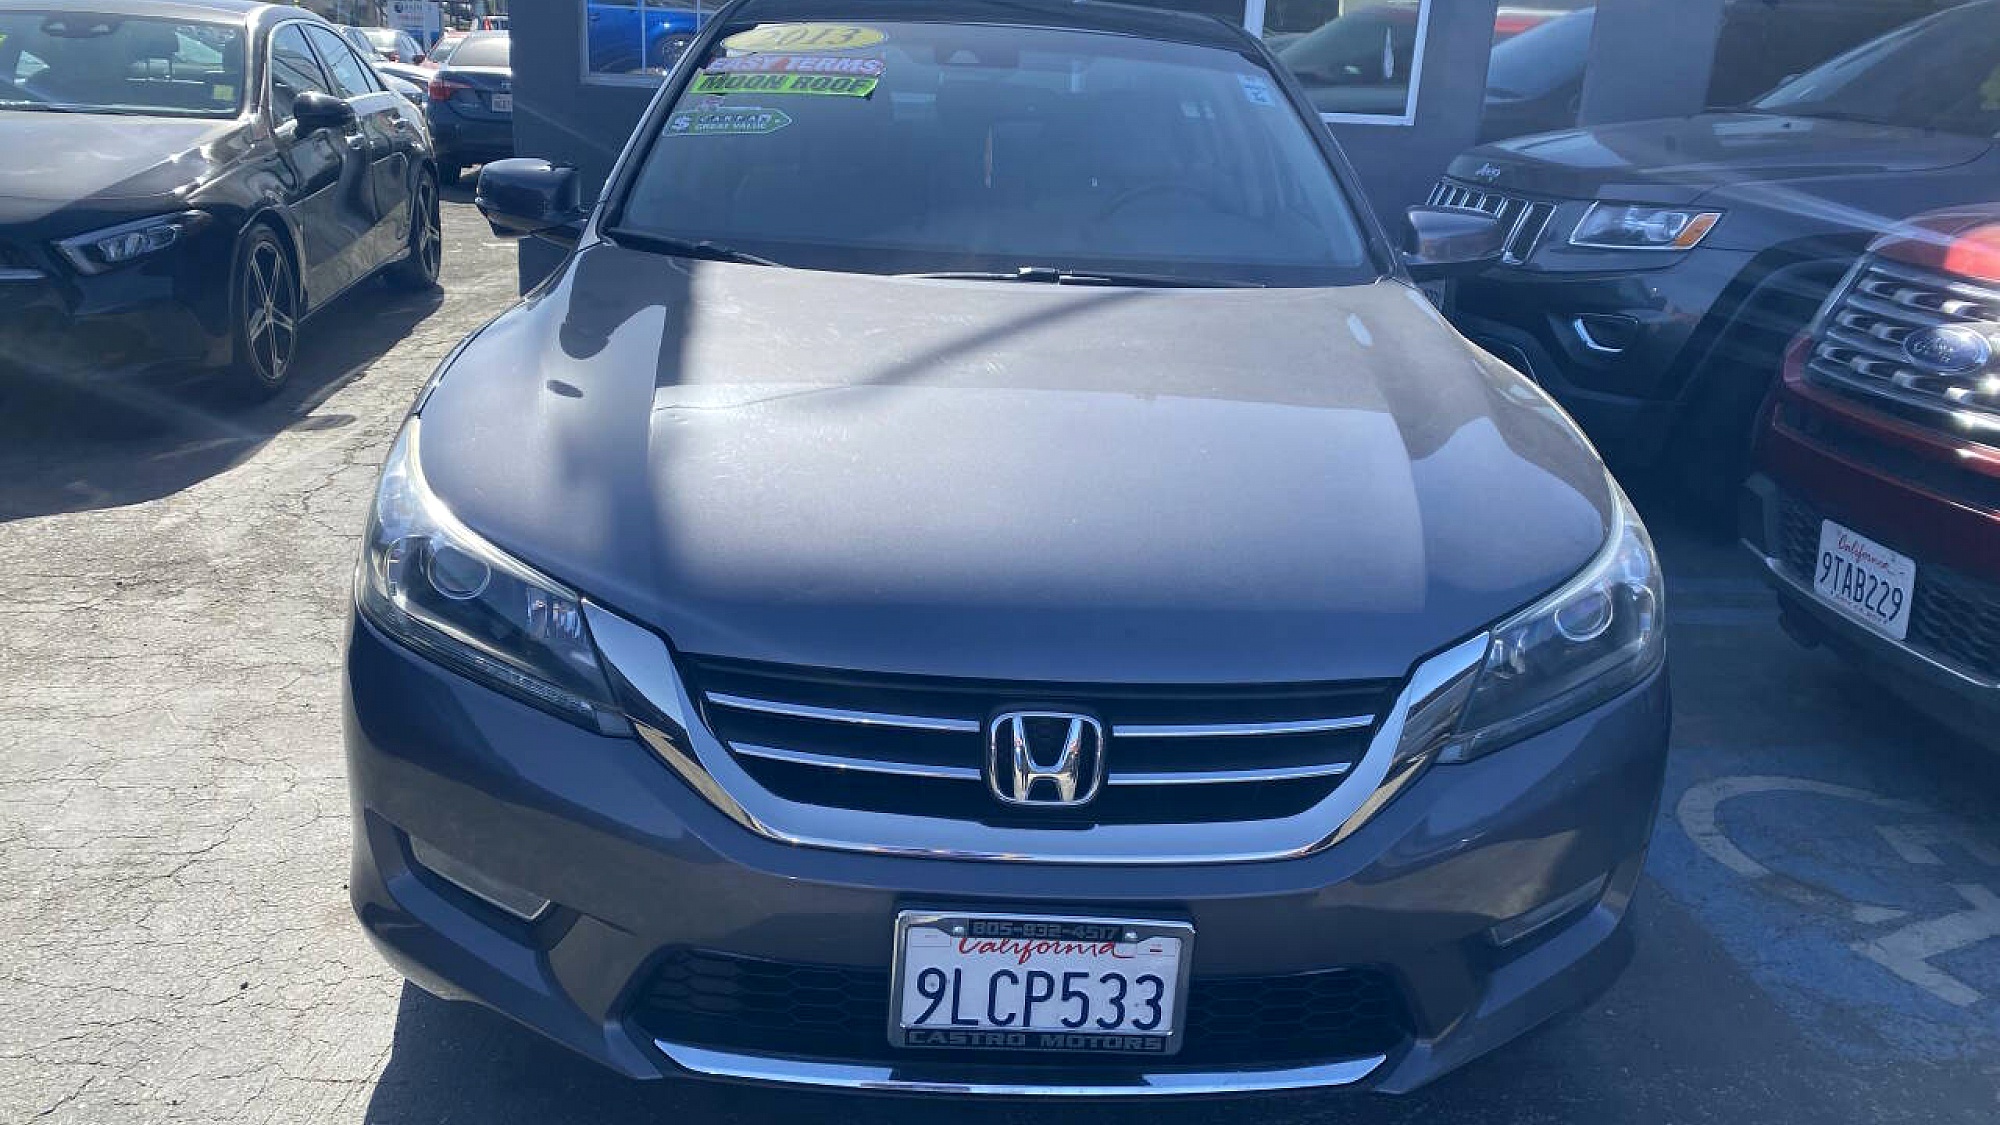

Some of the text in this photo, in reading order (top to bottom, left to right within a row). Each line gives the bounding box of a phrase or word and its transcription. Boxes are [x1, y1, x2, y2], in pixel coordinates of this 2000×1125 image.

[786, 57, 884, 74] TERMS
[700, 74, 874, 92] MOON ROOF
[1819, 551, 1904, 622] 9TAB229
[958, 936, 1136, 965] California
[913, 967, 1165, 1030] 9LCP533
[908, 1031, 1164, 1051] CASTRO MOTORS
